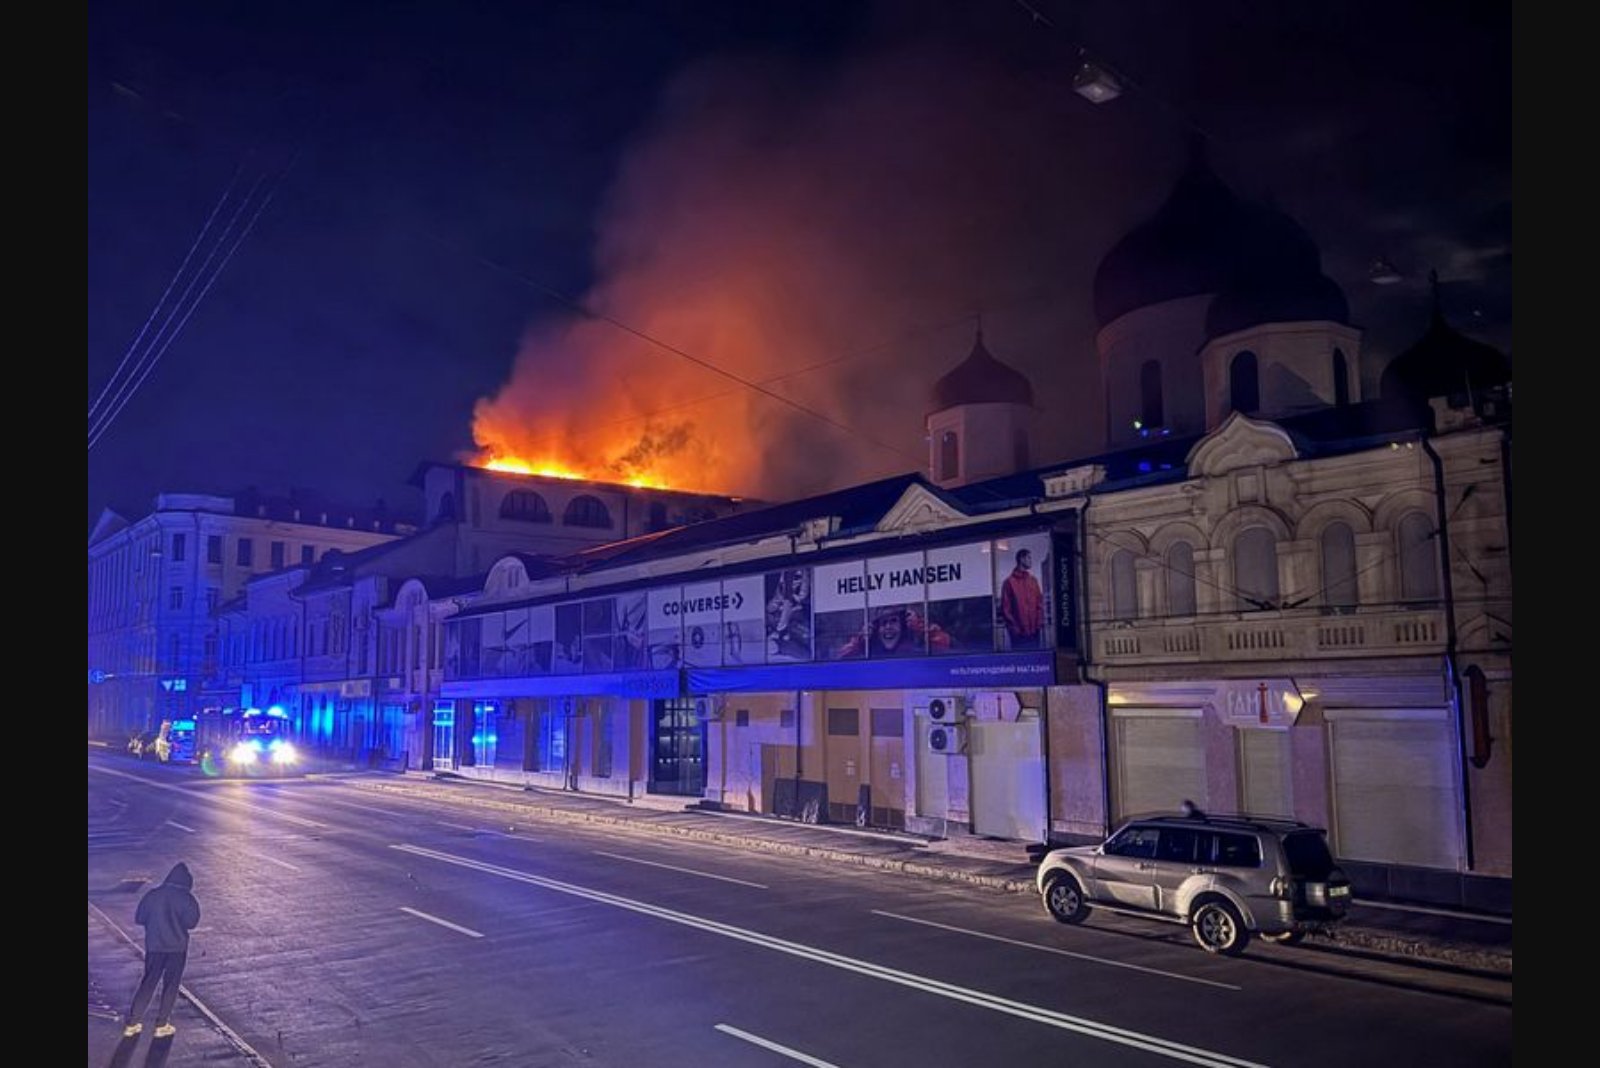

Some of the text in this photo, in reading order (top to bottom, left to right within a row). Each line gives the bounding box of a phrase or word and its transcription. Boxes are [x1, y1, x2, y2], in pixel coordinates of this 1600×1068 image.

[837, 564, 962, 595] HELLY HANSEN
[663, 595, 731, 616] CONVERSE
